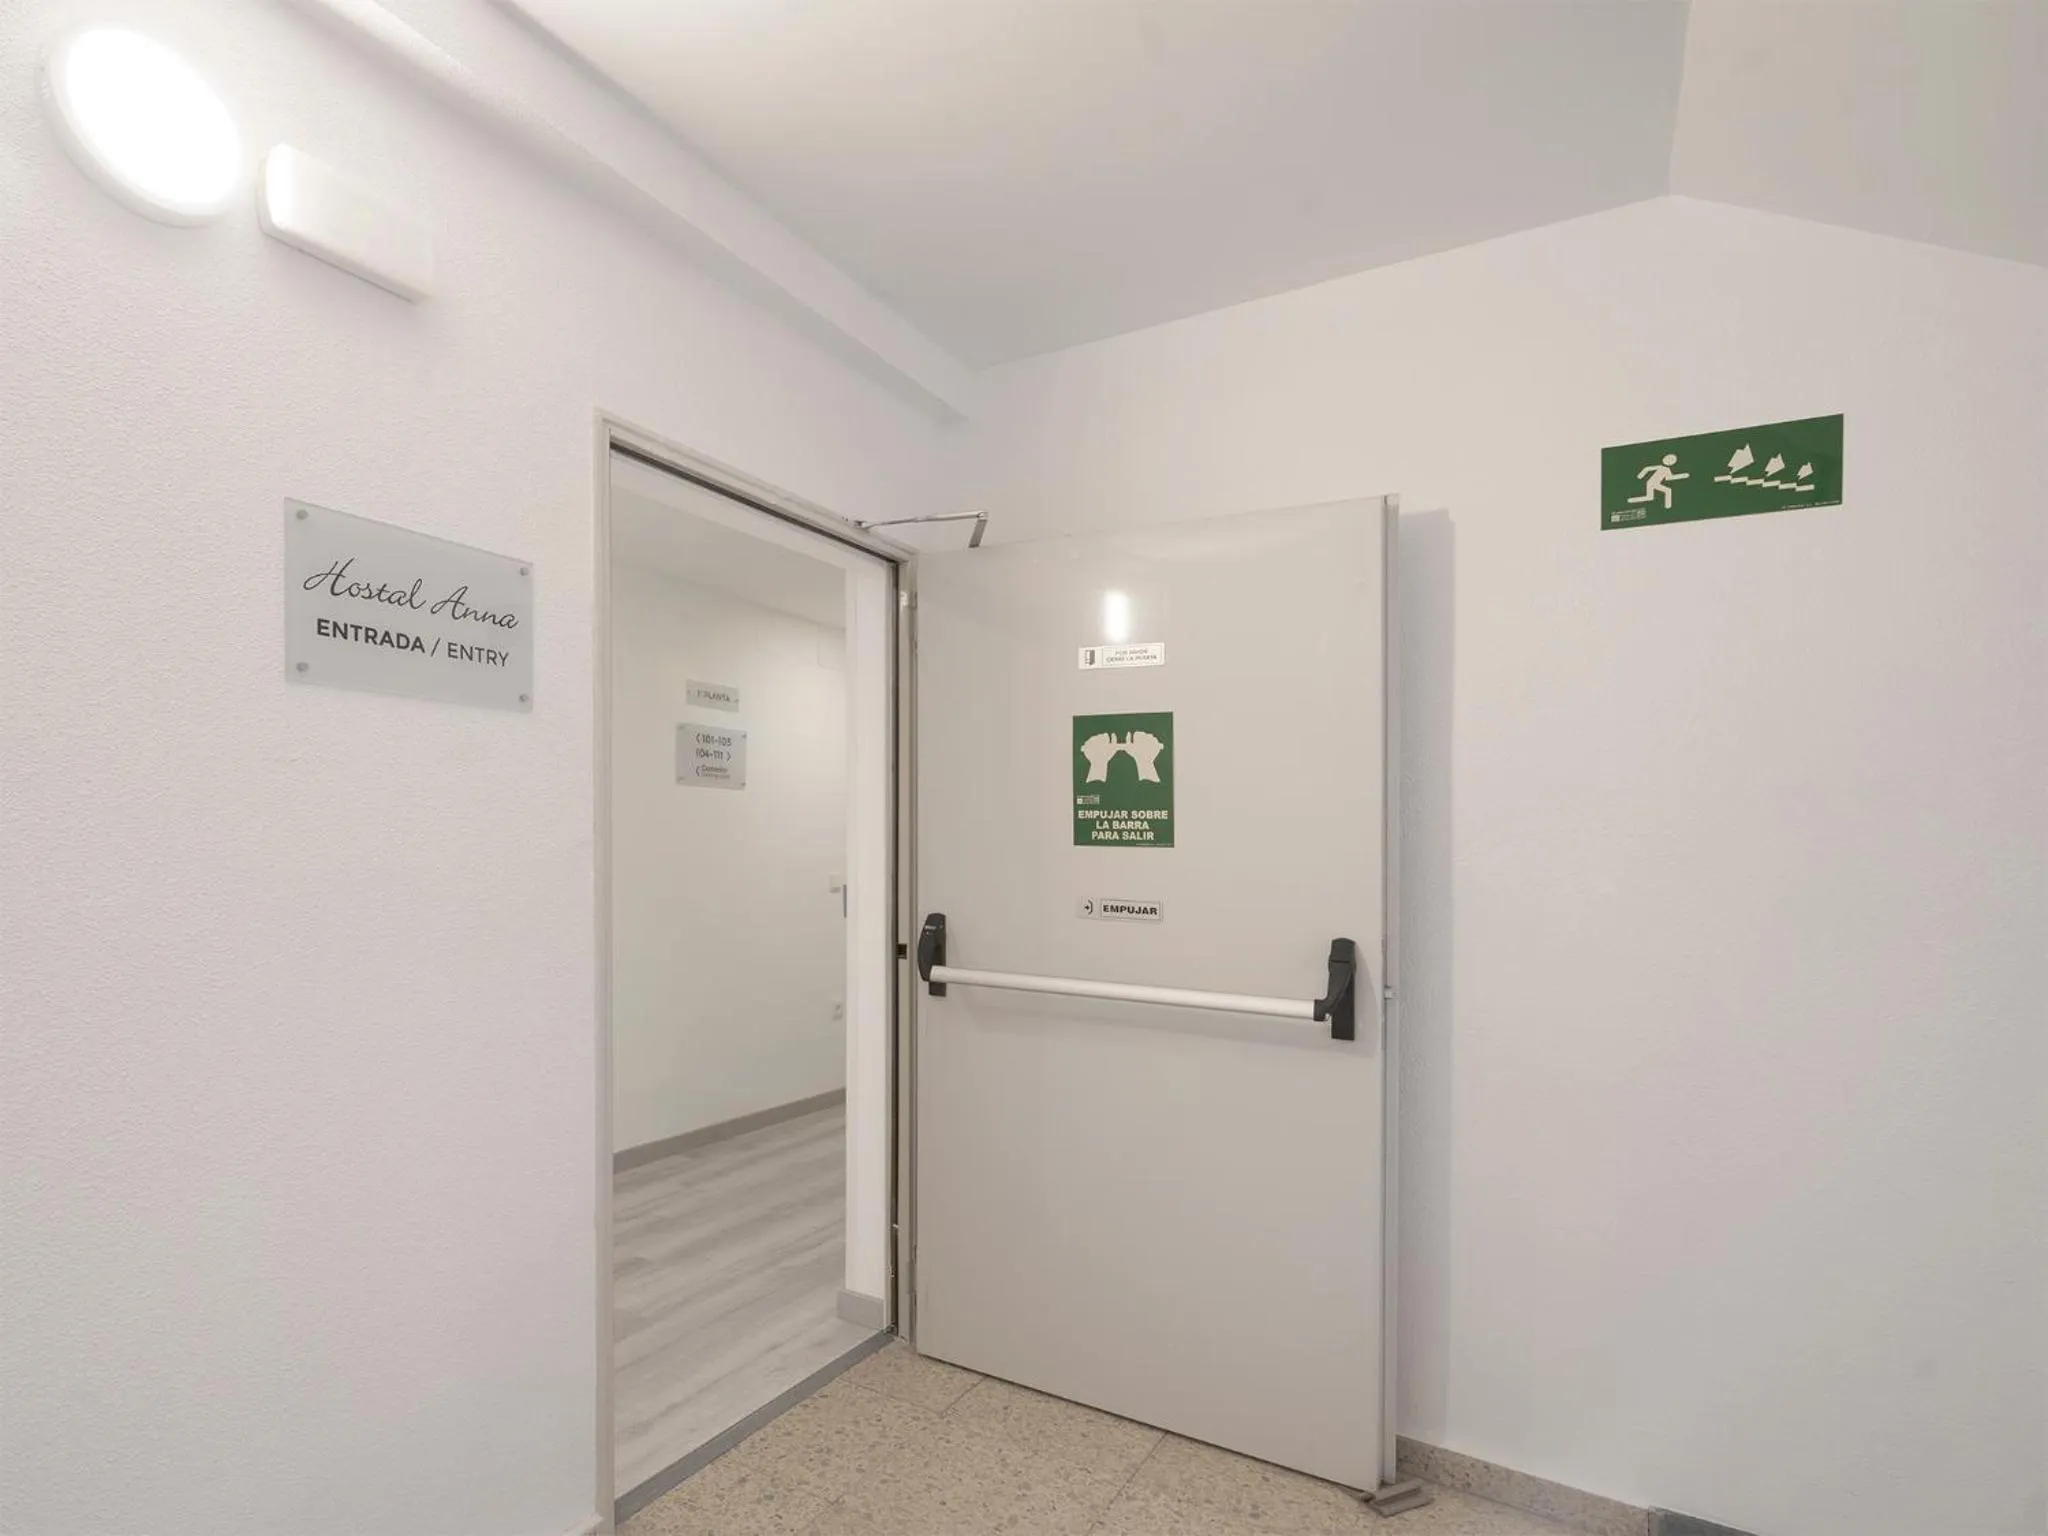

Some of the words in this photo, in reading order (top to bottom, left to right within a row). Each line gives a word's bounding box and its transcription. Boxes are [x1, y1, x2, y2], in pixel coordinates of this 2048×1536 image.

[303, 557, 427, 610] Hostal
[430, 585, 520, 630] Anna
[316, 618, 426, 654] ENTRADA
[430, 637, 441, 658] /
[446, 642, 510, 668] ENTRY
[1078, 810, 1129, 820] EMPUJAR
[1131, 809, 1169, 820] SOBRE
[1096, 821, 1110, 830] LA
[1112, 821, 1150, 830] BARRA
[1092, 831, 1120, 841] PARA
[1122, 831, 1155, 841] SALIR
[1103, 904, 1158, 916] EMPUJAR
